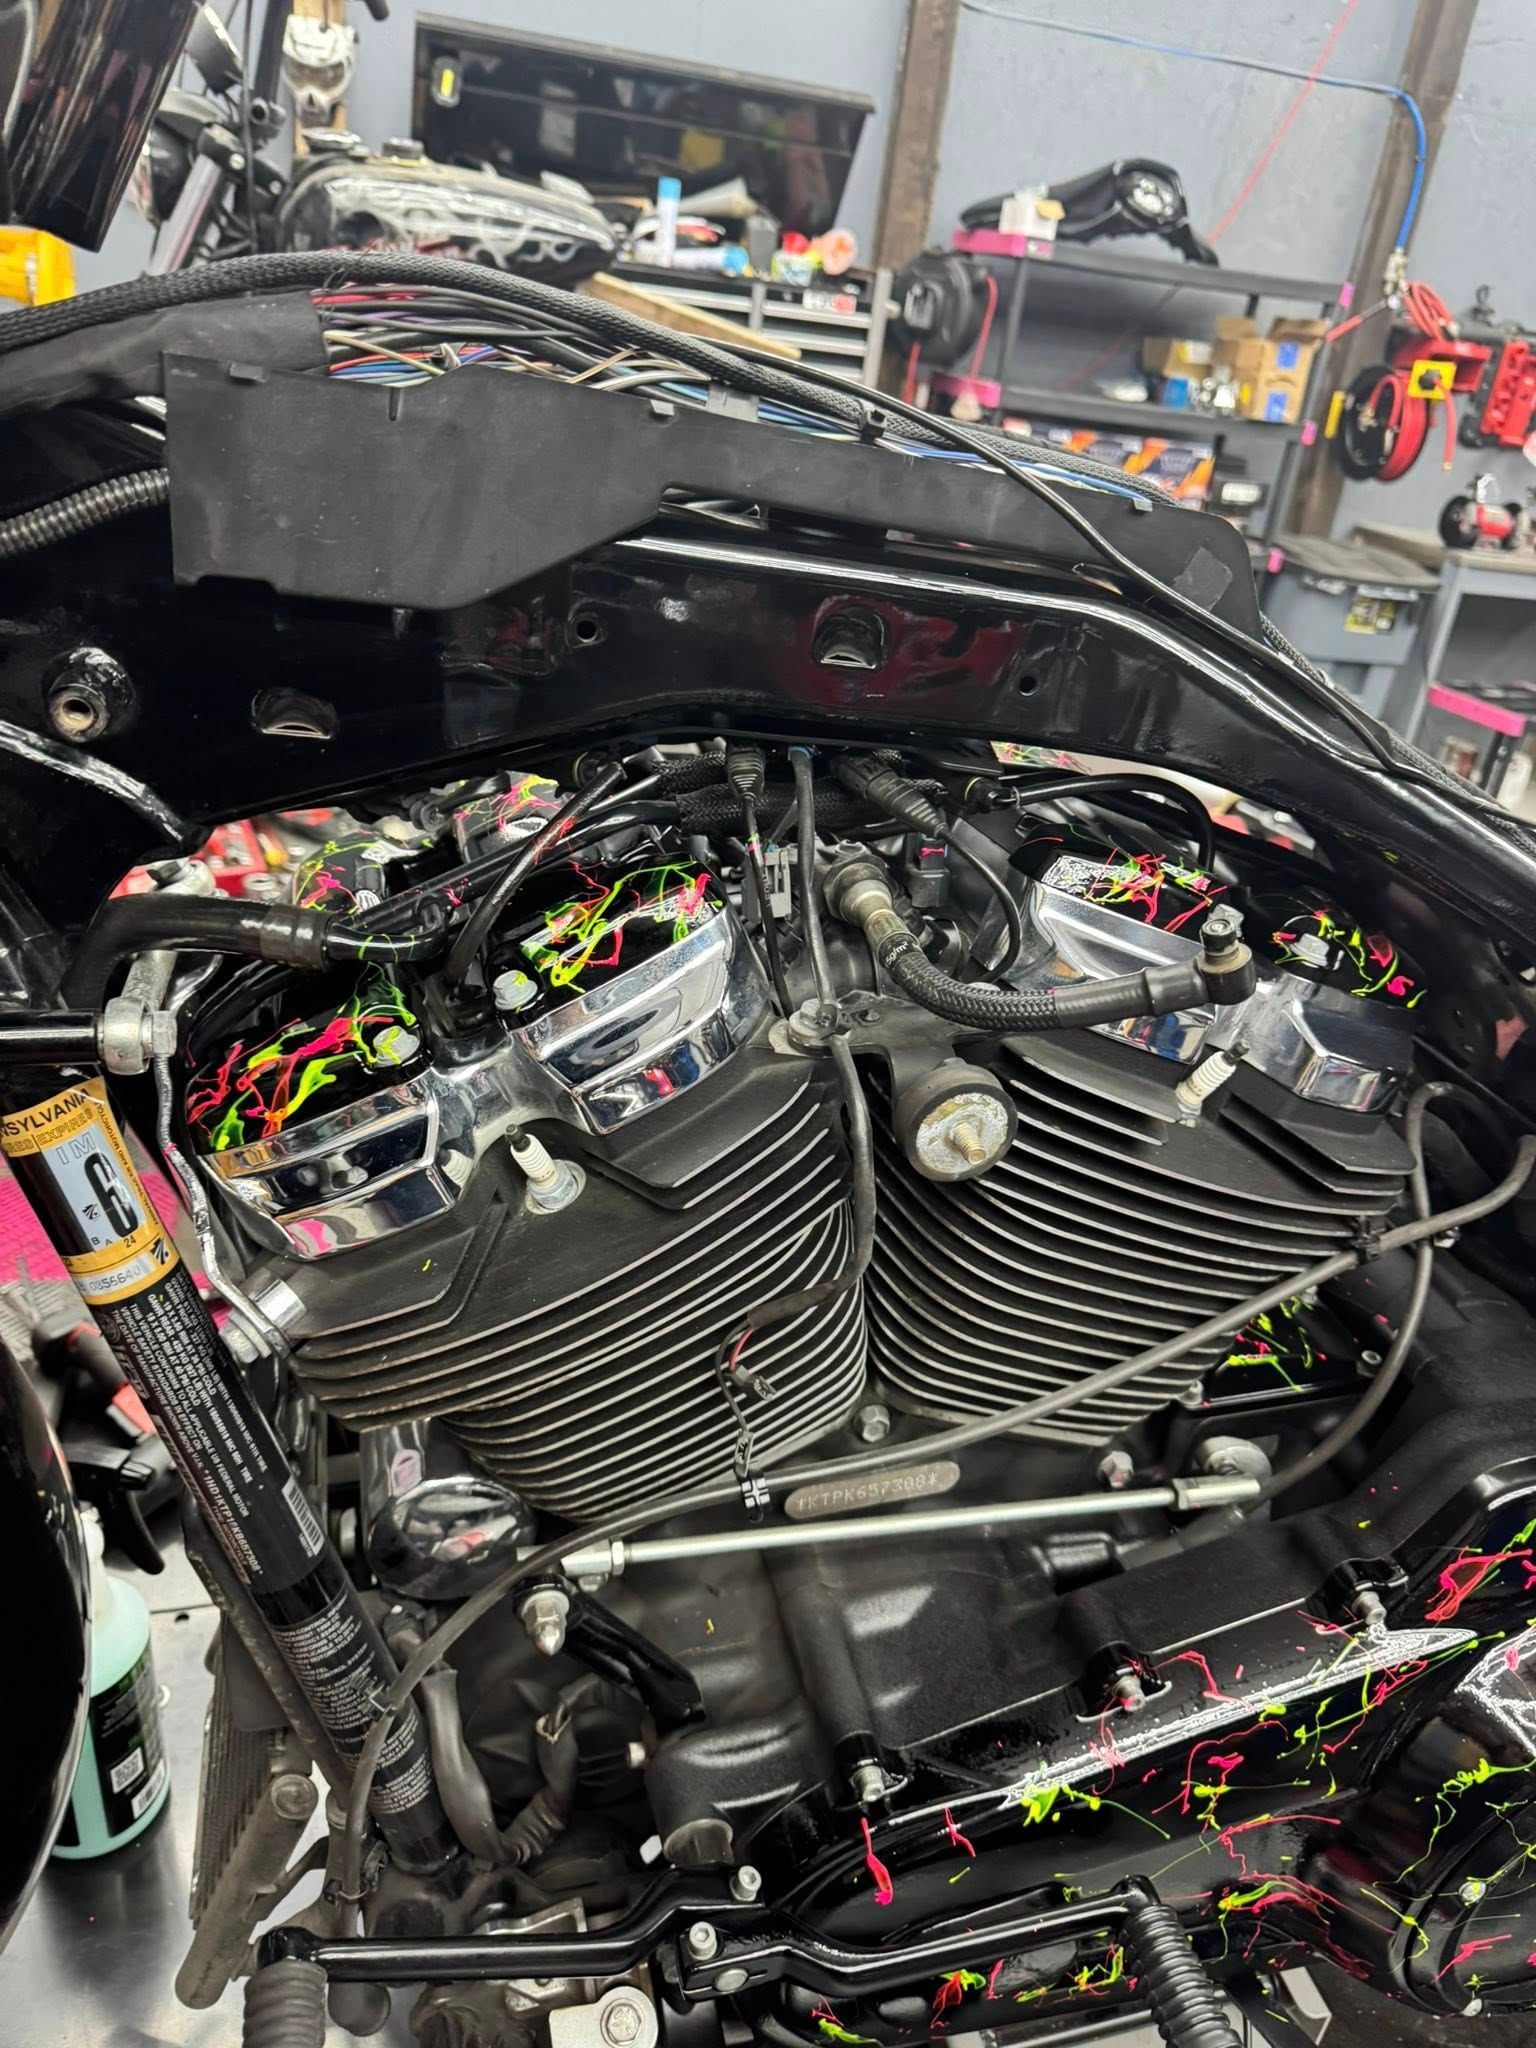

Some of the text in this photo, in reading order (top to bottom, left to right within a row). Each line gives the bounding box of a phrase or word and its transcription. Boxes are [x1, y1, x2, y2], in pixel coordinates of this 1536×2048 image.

[84, 1152, 138, 1238] 6
[128, 1302, 143, 1321] THIS
[146, 1292, 165, 1317] GAWR
[166, 1309, 176, 1318] X
[111, 1308, 124, 1325] THE
[119, 1305, 142, 1338] VEHICLE
[158, 1315, 175, 1337] REAR
[118, 1323, 135, 1345] DATE
[137, 1318, 160, 1351] VEHICLE
[177, 1329, 191, 1346] RIM
[129, 1342, 140, 1355] OF
[135, 1335, 156, 1365] SAFETY
[171, 1338, 184, 1353] 420
[184, 1343, 196, 1355] AT
[144, 1311, 201, 1407] 18 X 5.00 RIM AT 40 PSI COLD
[153, 1348, 181, 1390] CONFORMS
[177, 1351, 190, 1365] KG
[194, 1362, 207, 1376] PSI
[134, 1352, 168, 1407] MANUFACTURE
[150, 1362, 179, 1406] STANDARDS
[163, 1281, 180, 1305] GAWR
[174, 1303, 193, 1329] FRONT
[196, 1344, 208, 1357] KG
[215, 1381, 230, 1400] WITH
[254, 1454, 269, 1472] TIRE
[190, 1376, 204, 1391] LB)
[200, 1373, 217, 1396] COLD
[175, 1388, 187, 1401] TO
[180, 1398, 193, 1413] ALL
[197, 1388, 213, 1408] WITH
[163, 1404, 182, 1432] SHOWN
[173, 1403, 183, 1415] IN
[177, 1411, 197, 1440] EFFECT
[187, 1411, 216, 1455] APPLICABLE
[177, 1429, 195, 1455] ABOVE
[191, 1437, 203, 1451] ON
[209, 1452, 221, 1464] US
[214, 1461, 237, 1495] FEDERAL
[238, 1465, 253, 1484] TIRE
[230, 1491, 250, 1518] MOTOR
